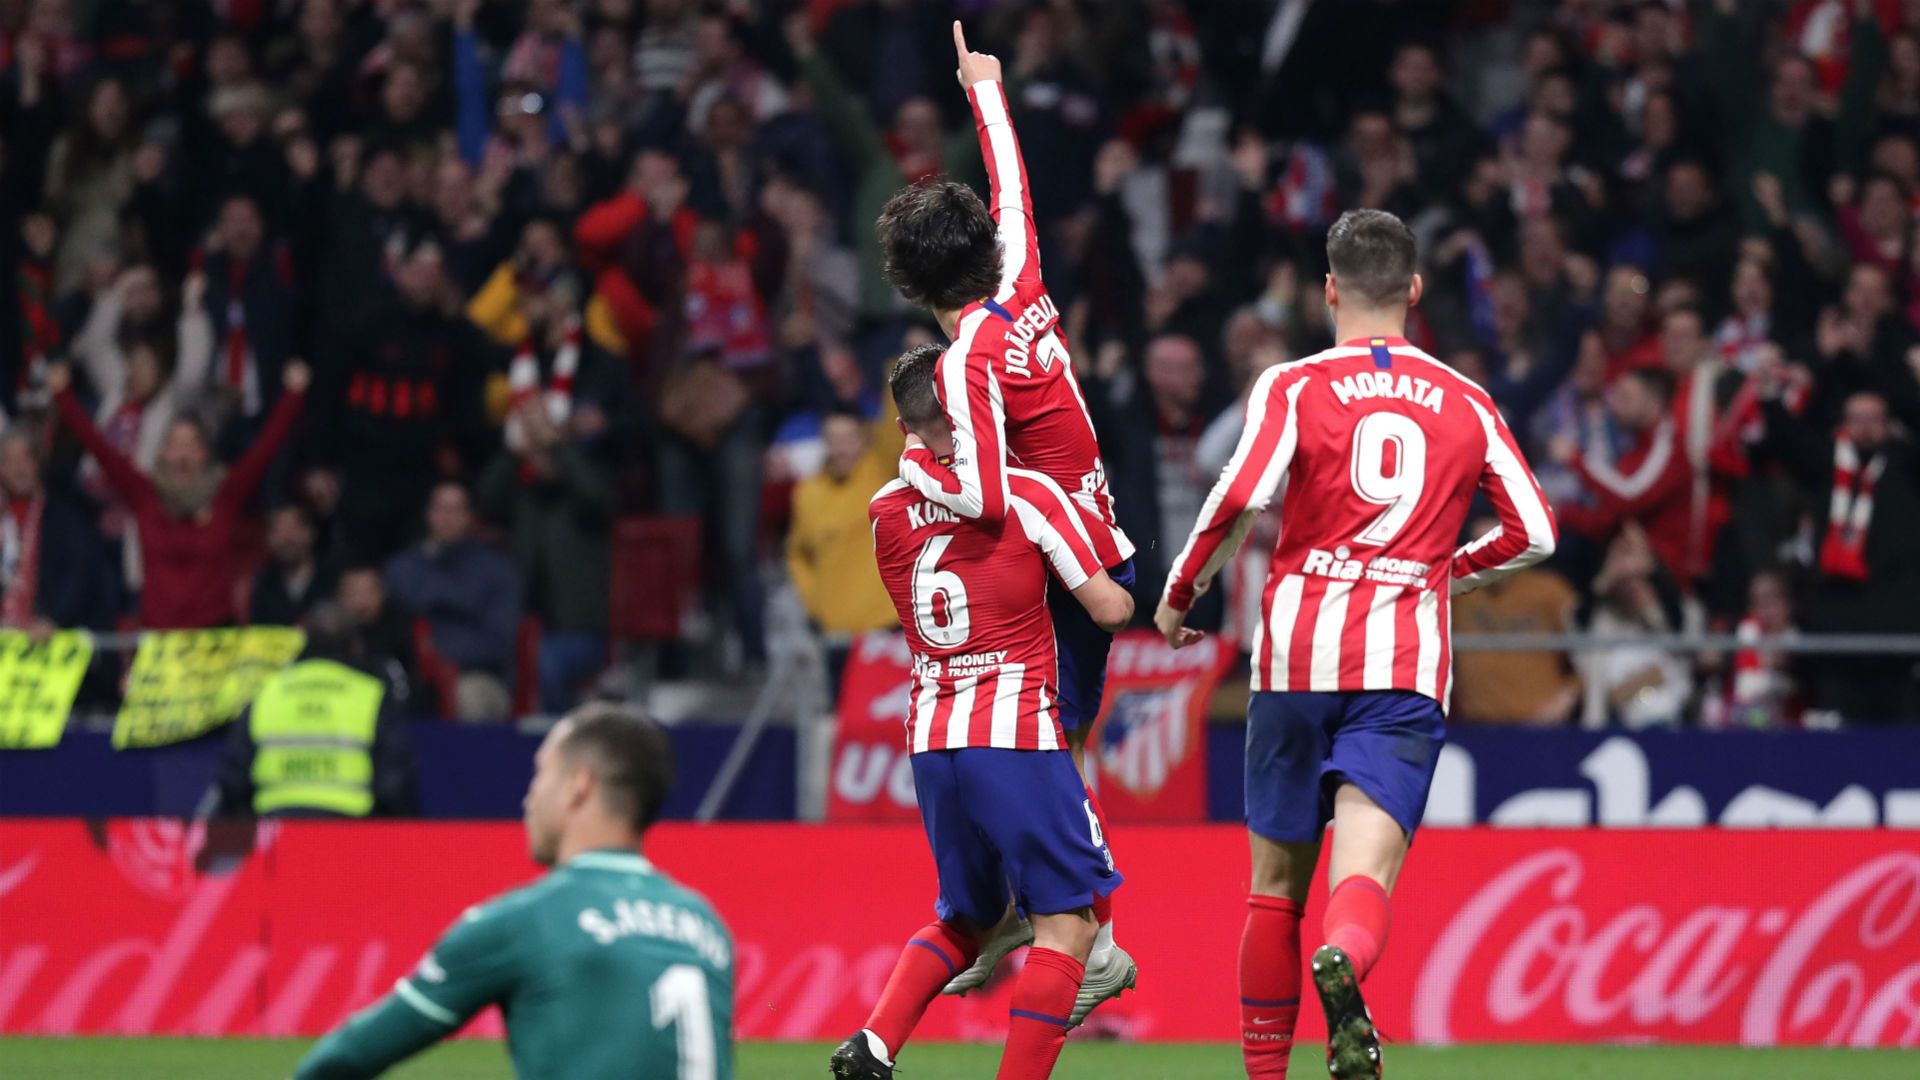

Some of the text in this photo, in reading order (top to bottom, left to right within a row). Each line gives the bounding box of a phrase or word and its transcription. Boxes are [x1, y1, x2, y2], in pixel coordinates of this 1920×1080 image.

[1330, 371, 1444, 414] MORATA
[1350, 411, 1427, 546] 9
[1301, 545, 1431, 580] Ria MONEY
[911, 535, 971, 649] 6
[948, 650, 1008, 667] MONEY
[1083, 798, 1104, 848] 6
[649, 963, 717, 1080] 1
